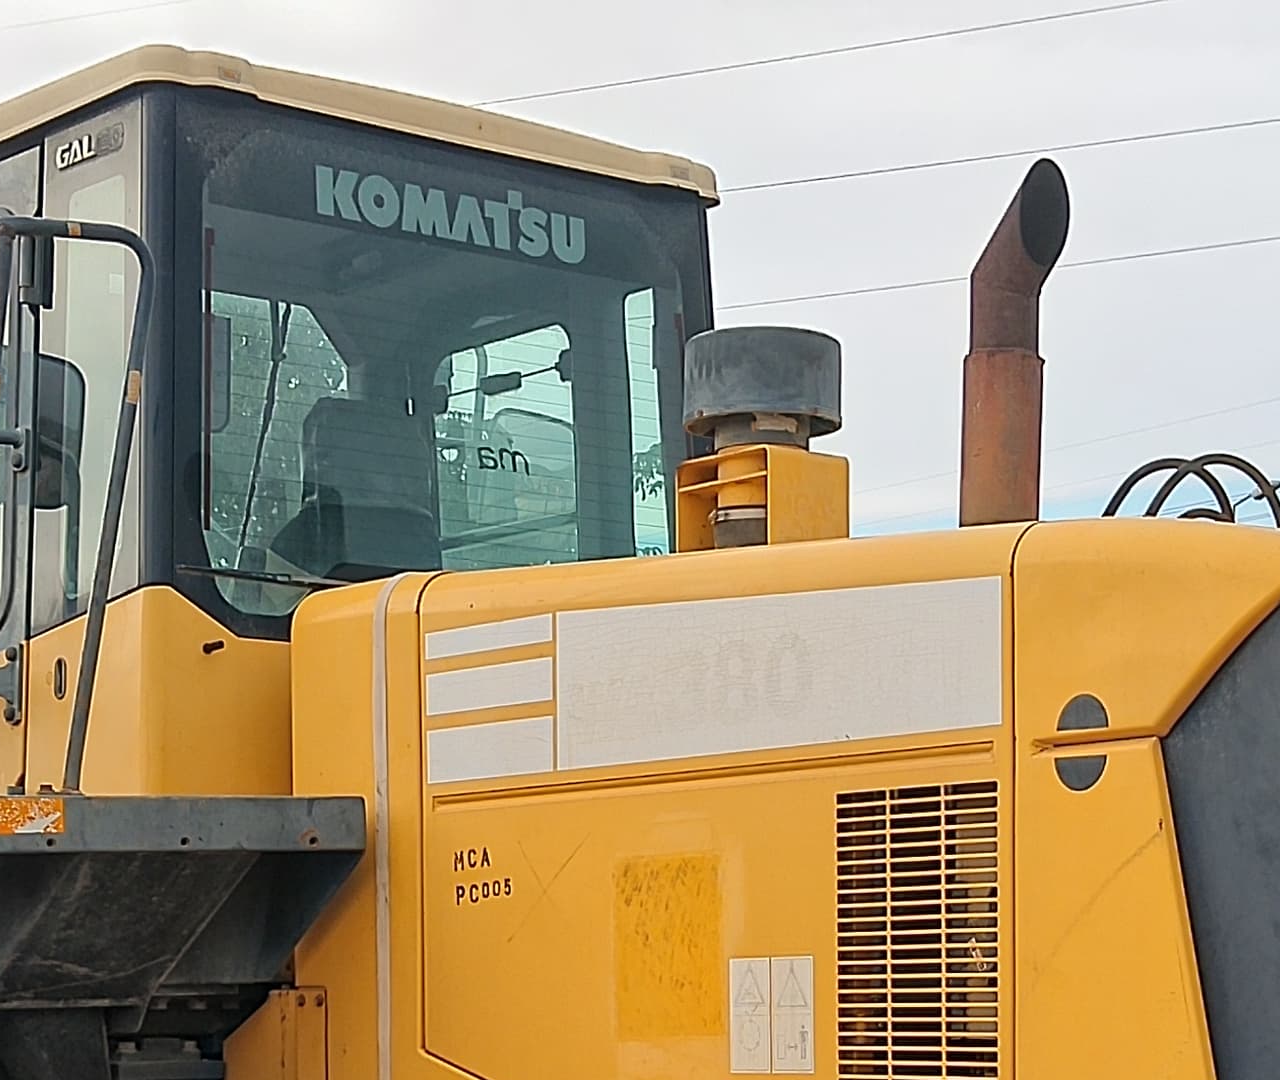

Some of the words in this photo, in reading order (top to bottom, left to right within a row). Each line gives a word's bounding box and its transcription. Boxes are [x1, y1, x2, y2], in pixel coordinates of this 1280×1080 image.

[315, 165, 586, 264] KOMATSU
[453, 846, 491, 873] MCA
[455, 877, 512, 906] PC005
